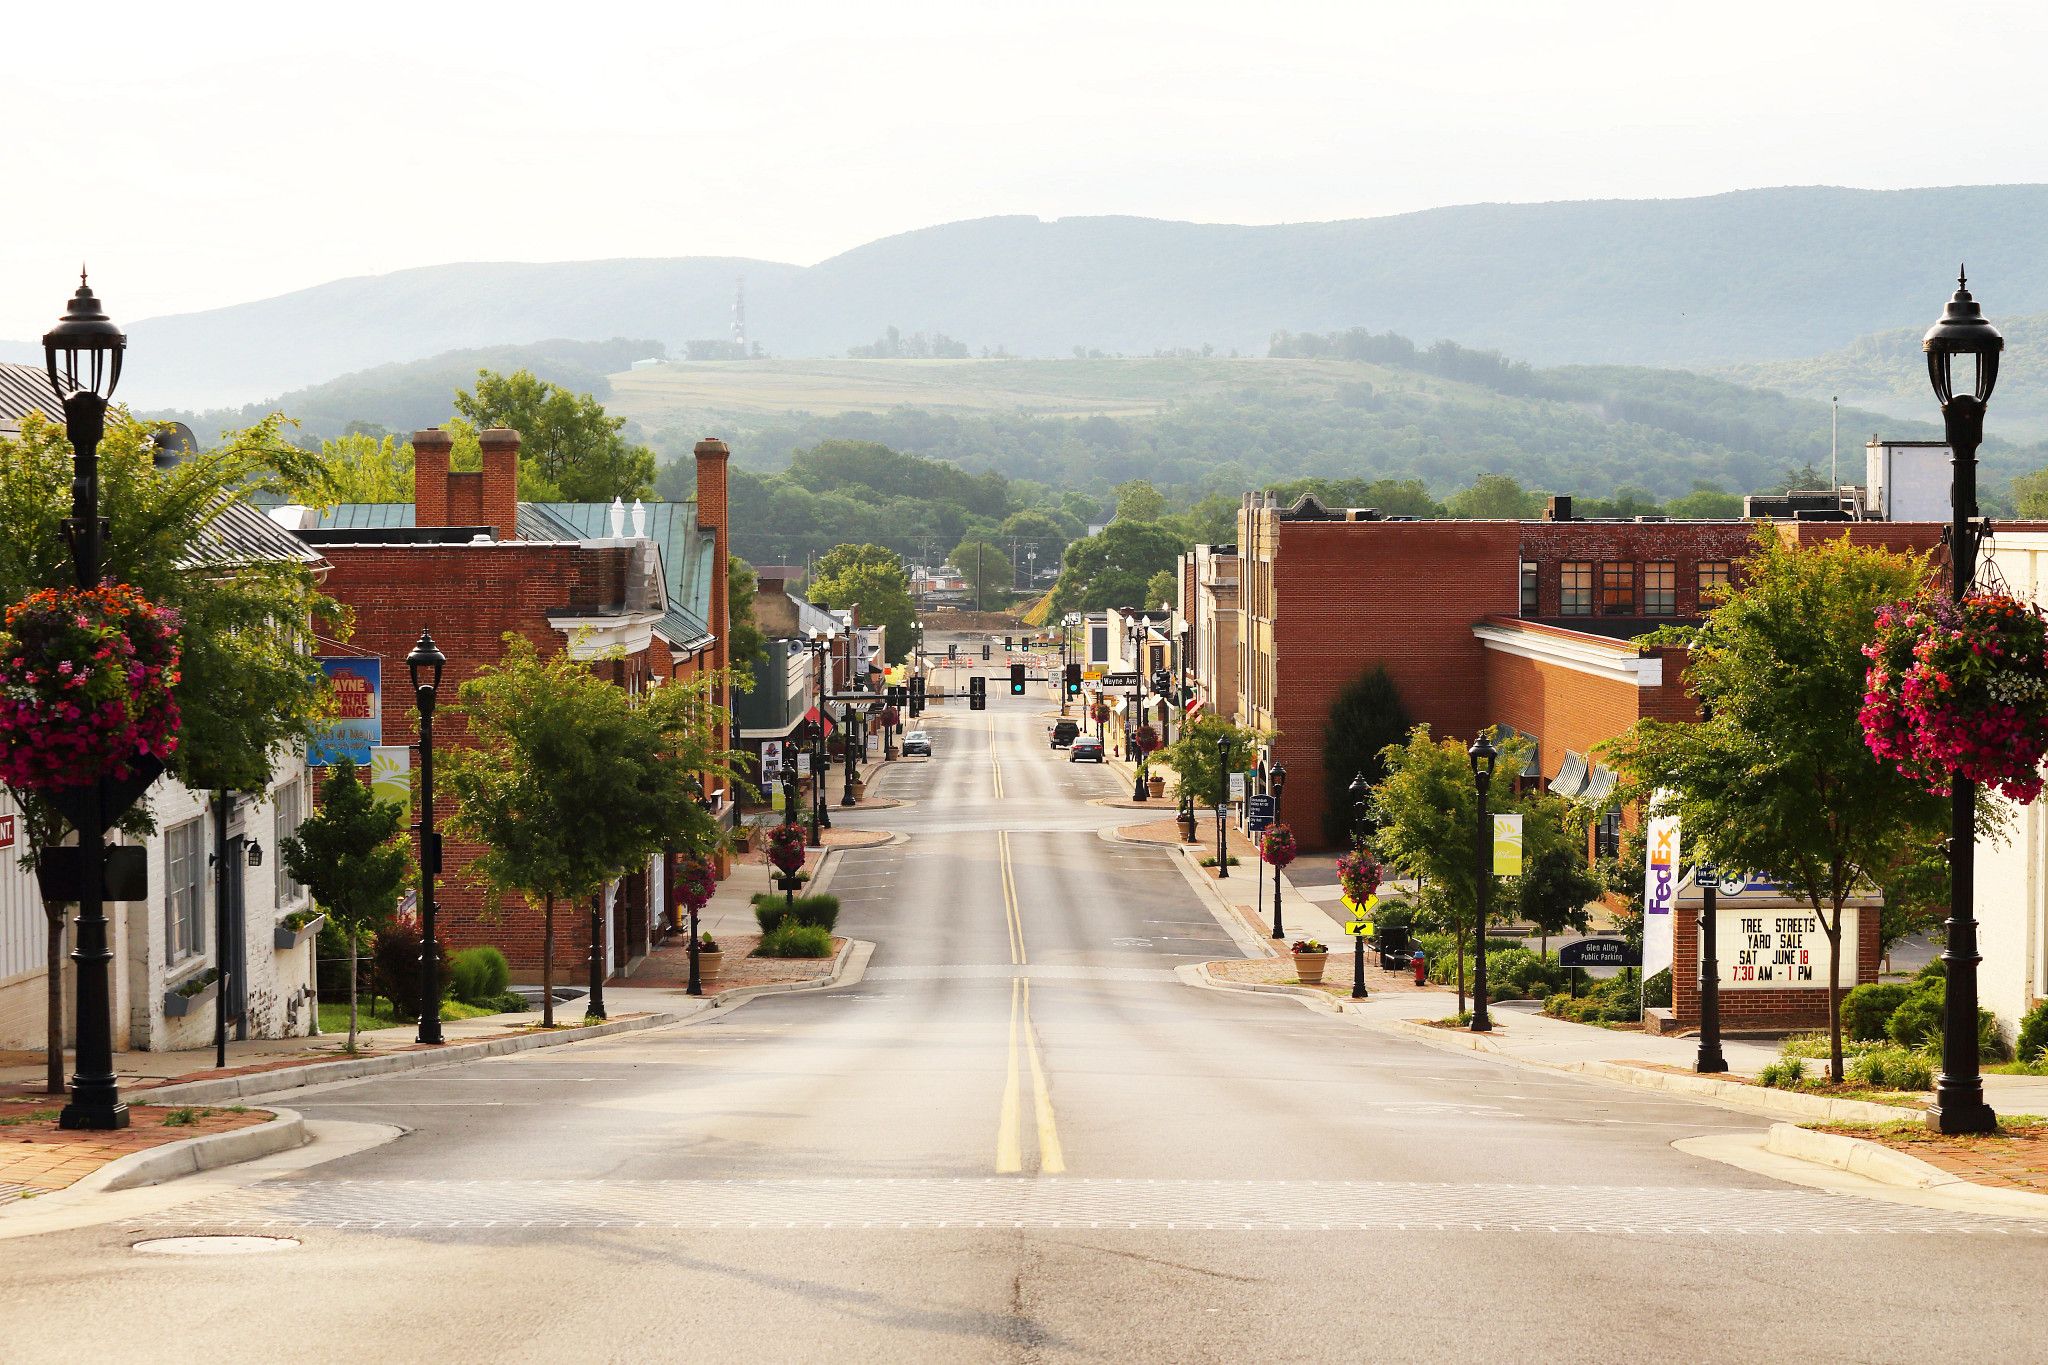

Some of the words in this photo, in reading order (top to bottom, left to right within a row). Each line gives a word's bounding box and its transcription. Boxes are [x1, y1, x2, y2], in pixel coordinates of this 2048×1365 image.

[1103, 676, 1123, 686] Wayne
[1126, 676, 1137, 685] Ave
[1648, 830, 1672, 915] FedEx
[1741, 918, 1762, 933] TREE
[1776, 918, 1815, 933] STREETS
[1585, 943, 1600, 951] Glen
[1602, 943, 1618, 953] Alley
[1748, 934, 1771, 949] YARD
[1780, 934, 1803, 949] SALE
[1581, 953, 1599, 961] Public
[1600, 953, 1623, 962] Parking
[1739, 950, 1758, 965] SAT
[1772, 950, 1795, 965] JUNE
[1799, 949, 1809, 965] 18
[1732, 966, 1754, 981] 7:30
[1758, 966, 1772, 981] AM
[1788, 966, 1792, 981] 1
[1798, 966, 1812, 981] PM
